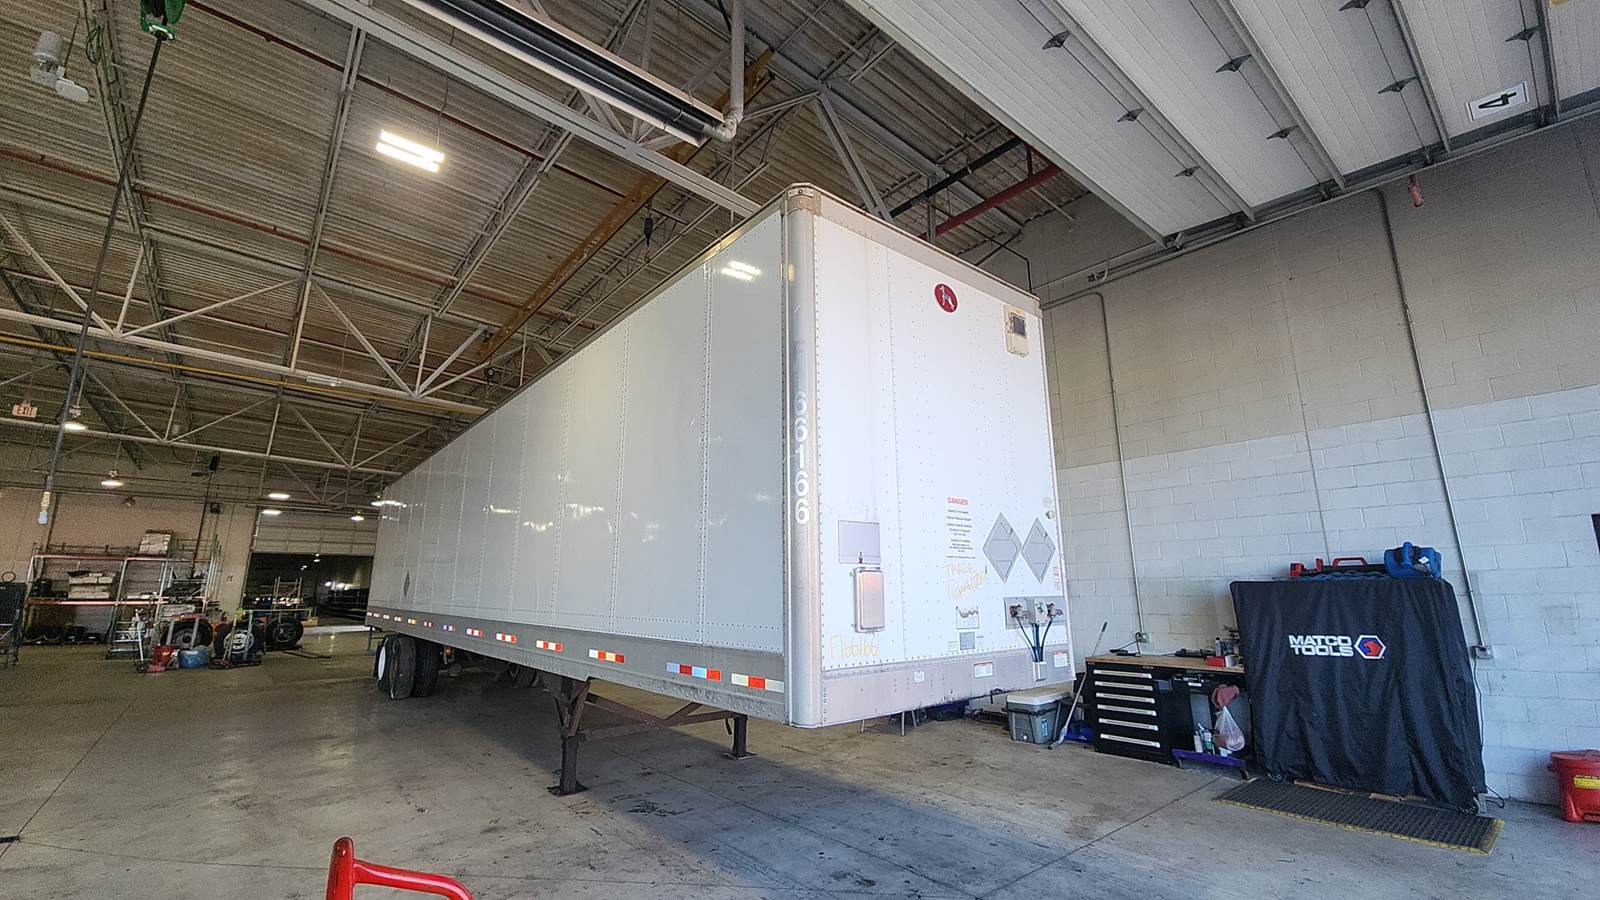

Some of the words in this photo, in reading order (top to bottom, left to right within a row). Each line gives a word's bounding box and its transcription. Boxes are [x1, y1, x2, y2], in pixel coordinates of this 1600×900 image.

[1478, 92, 1517, 109] 4
[947, 496, 969, 506] DANGER
[1288, 634, 1352, 647] MATCO
[1290, 644, 1354, 657] TOOLS
